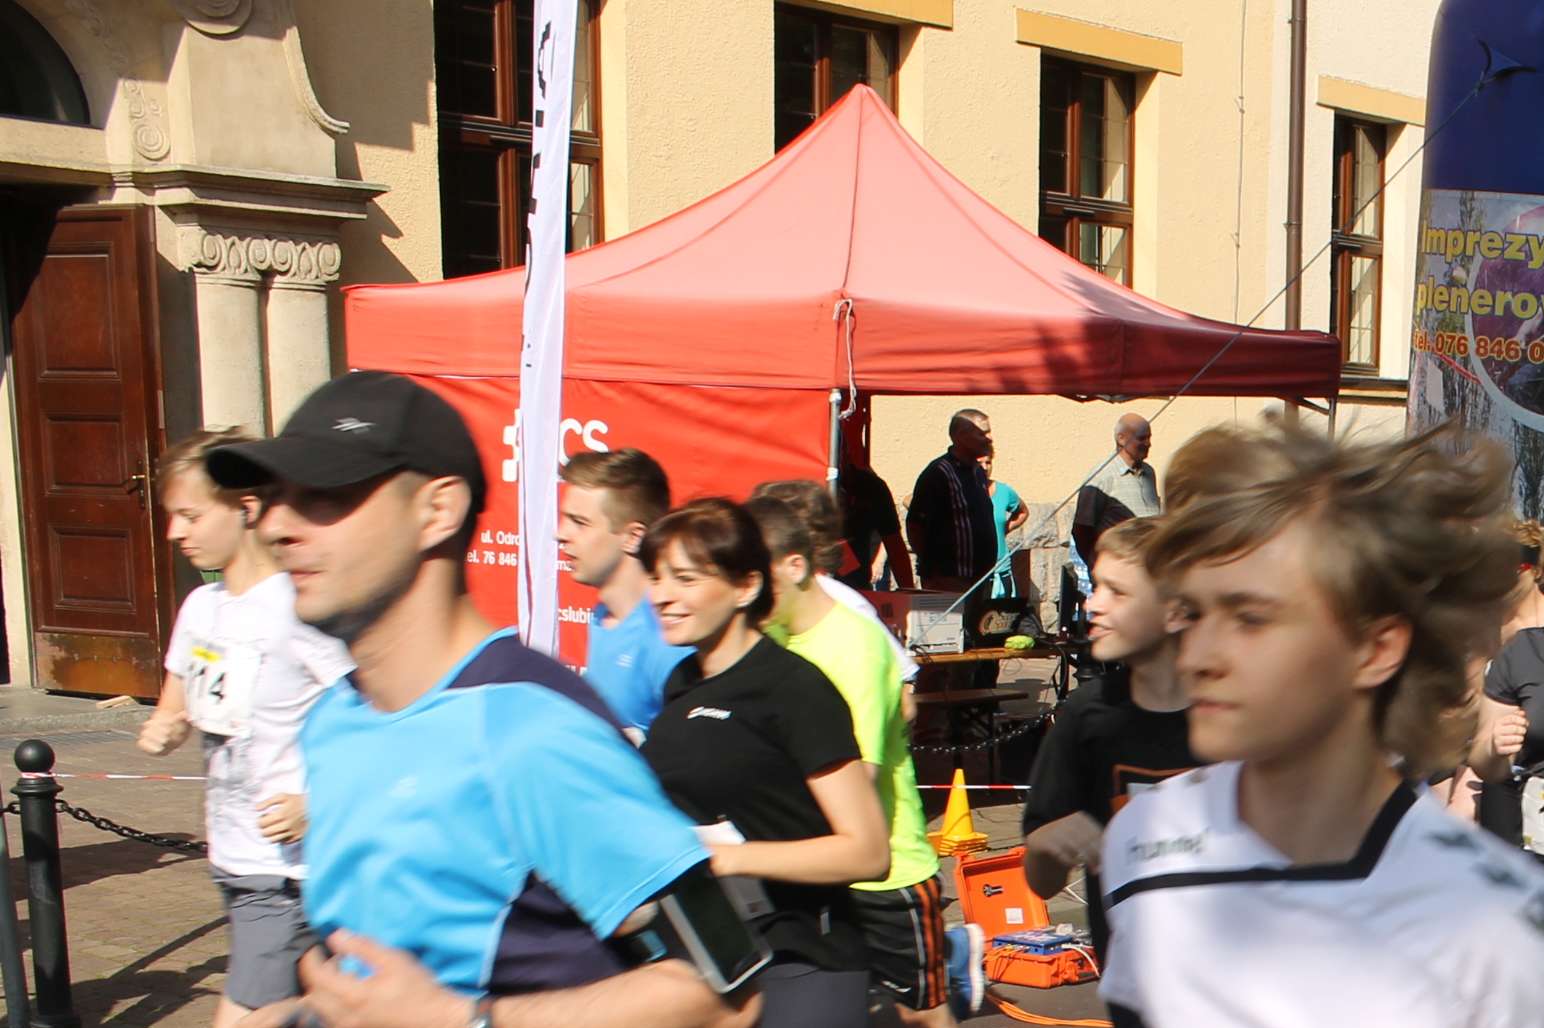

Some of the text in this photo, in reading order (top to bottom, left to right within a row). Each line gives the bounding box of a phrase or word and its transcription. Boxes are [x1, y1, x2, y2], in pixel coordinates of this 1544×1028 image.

[1433, 332, 1470, 358] 076
[1474, 335, 1522, 363] 846
[557, 417, 610, 468] CS
[467, 549, 517, 567] el. 76 846
